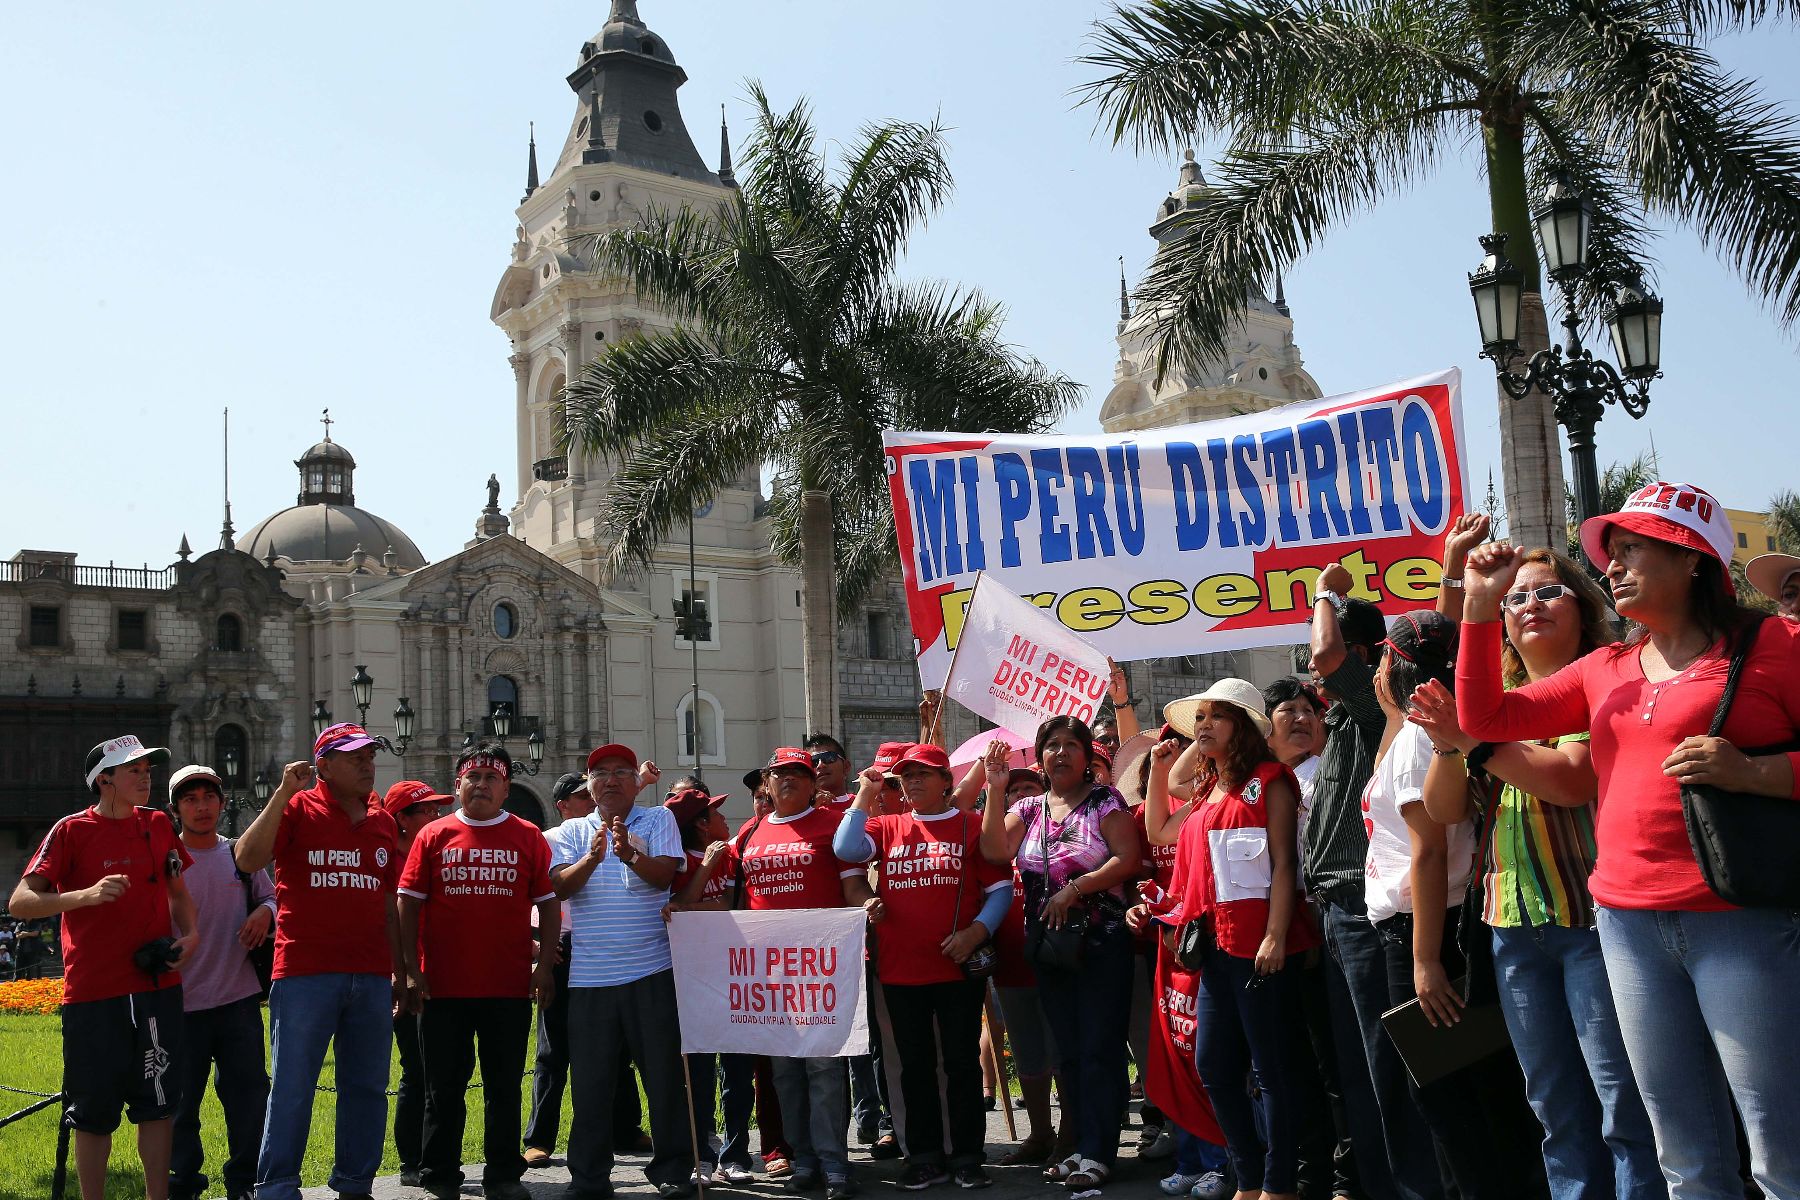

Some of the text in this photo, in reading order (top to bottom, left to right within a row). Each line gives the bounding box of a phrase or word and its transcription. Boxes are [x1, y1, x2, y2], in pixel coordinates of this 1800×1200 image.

[908, 401, 1444, 583] MI PERÚ DISTRITO
[1007, 634, 1107, 701] MI PERU
[988, 686, 1015, 704] CIUDAD
[1014, 700, 1039, 717] LIMPIA
[993, 660, 1093, 726] DISTRITO
[786, 751, 806, 760] SPORT
[308, 850, 325, 866] MI
[327, 848, 361, 868] PERÚ
[441, 847, 518, 865] MI PERU
[742, 841, 813, 858] MI PERU
[889, 841, 964, 859] MI PERU
[1152, 845, 1160, 857] El
[741, 852, 813, 874] DISTRITO
[886, 856, 962, 876] DISTRITO
[310, 871, 381, 892] DISTRITO
[440, 866, 518, 883] DISTRITO
[750, 869, 804, 885] El derecho
[888, 873, 960, 890] Ponle tu firma
[444, 884, 513, 897] Ponle tu firma
[753, 881, 804, 897] de un pueblo
[728, 947, 837, 976] MI PERU
[729, 982, 837, 1013] DISTRITO
[1165, 985, 1199, 1016] PERU
[730, 1014, 836, 1026] CIUDAD LIMPIA Y SALUDABLE
[144, 1048, 155, 1080] NIKE
